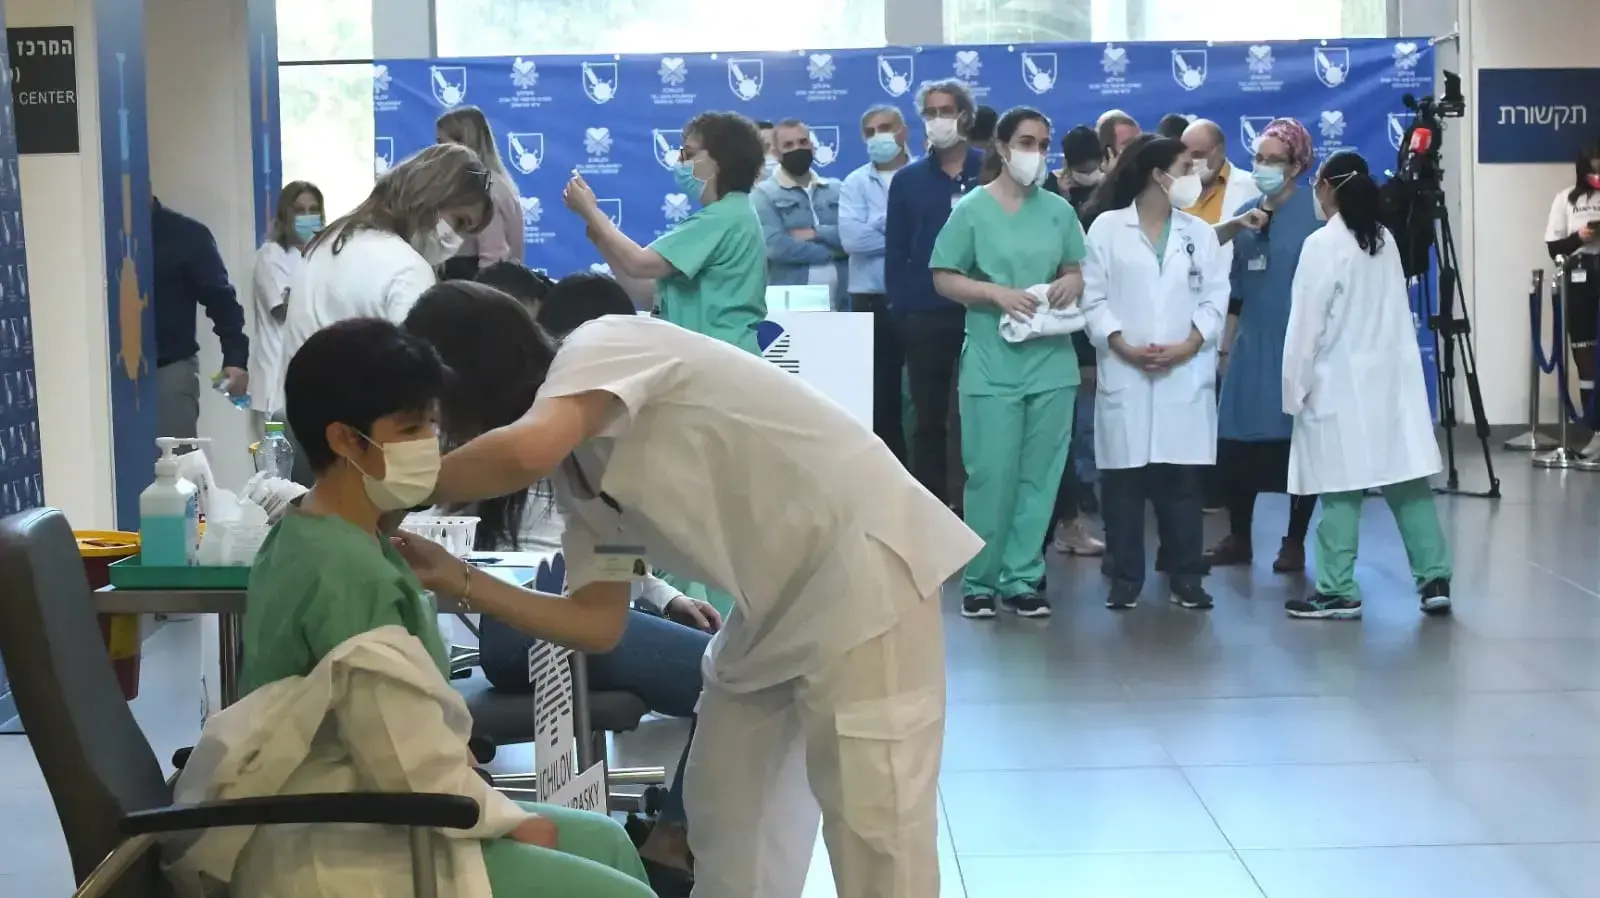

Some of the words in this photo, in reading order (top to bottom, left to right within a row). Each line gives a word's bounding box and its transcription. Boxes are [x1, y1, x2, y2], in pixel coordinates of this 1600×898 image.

[17, 40, 73, 56] המרכז
[18, 90, 76, 106] CENTER
[1497, 105, 1587, 131] תקשורת
[539, 749, 572, 803] ICHILOV
